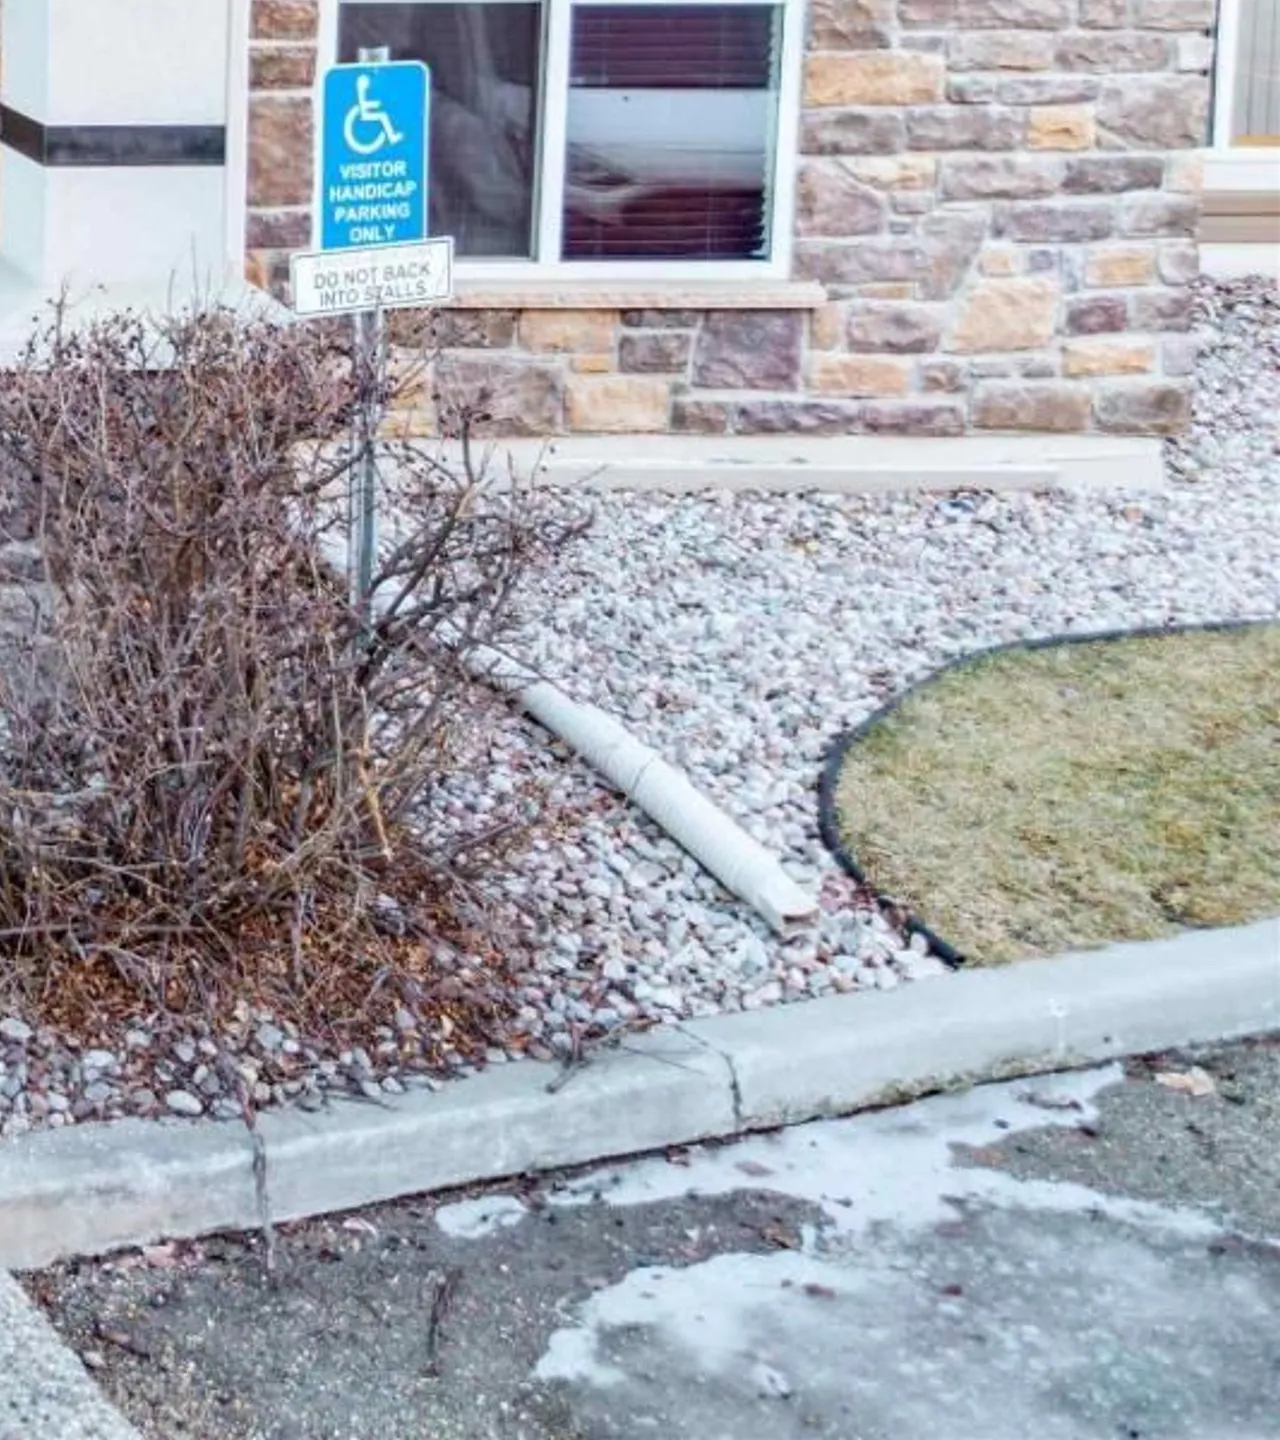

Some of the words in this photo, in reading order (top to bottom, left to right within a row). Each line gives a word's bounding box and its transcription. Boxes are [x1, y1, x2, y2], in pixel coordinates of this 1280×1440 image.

[340, 160, 407, 179] VISITOR
[329, 180, 417, 203] HANDICAP
[334, 202, 410, 223] PARKING
[349, 223, 396, 243] ONLY
[314, 271, 338, 290] DO
[344, 266, 377, 287] NOT
[383, 261, 431, 282] BACK
[319, 288, 359, 307] INTO
[363, 279, 427, 303] STALLS
